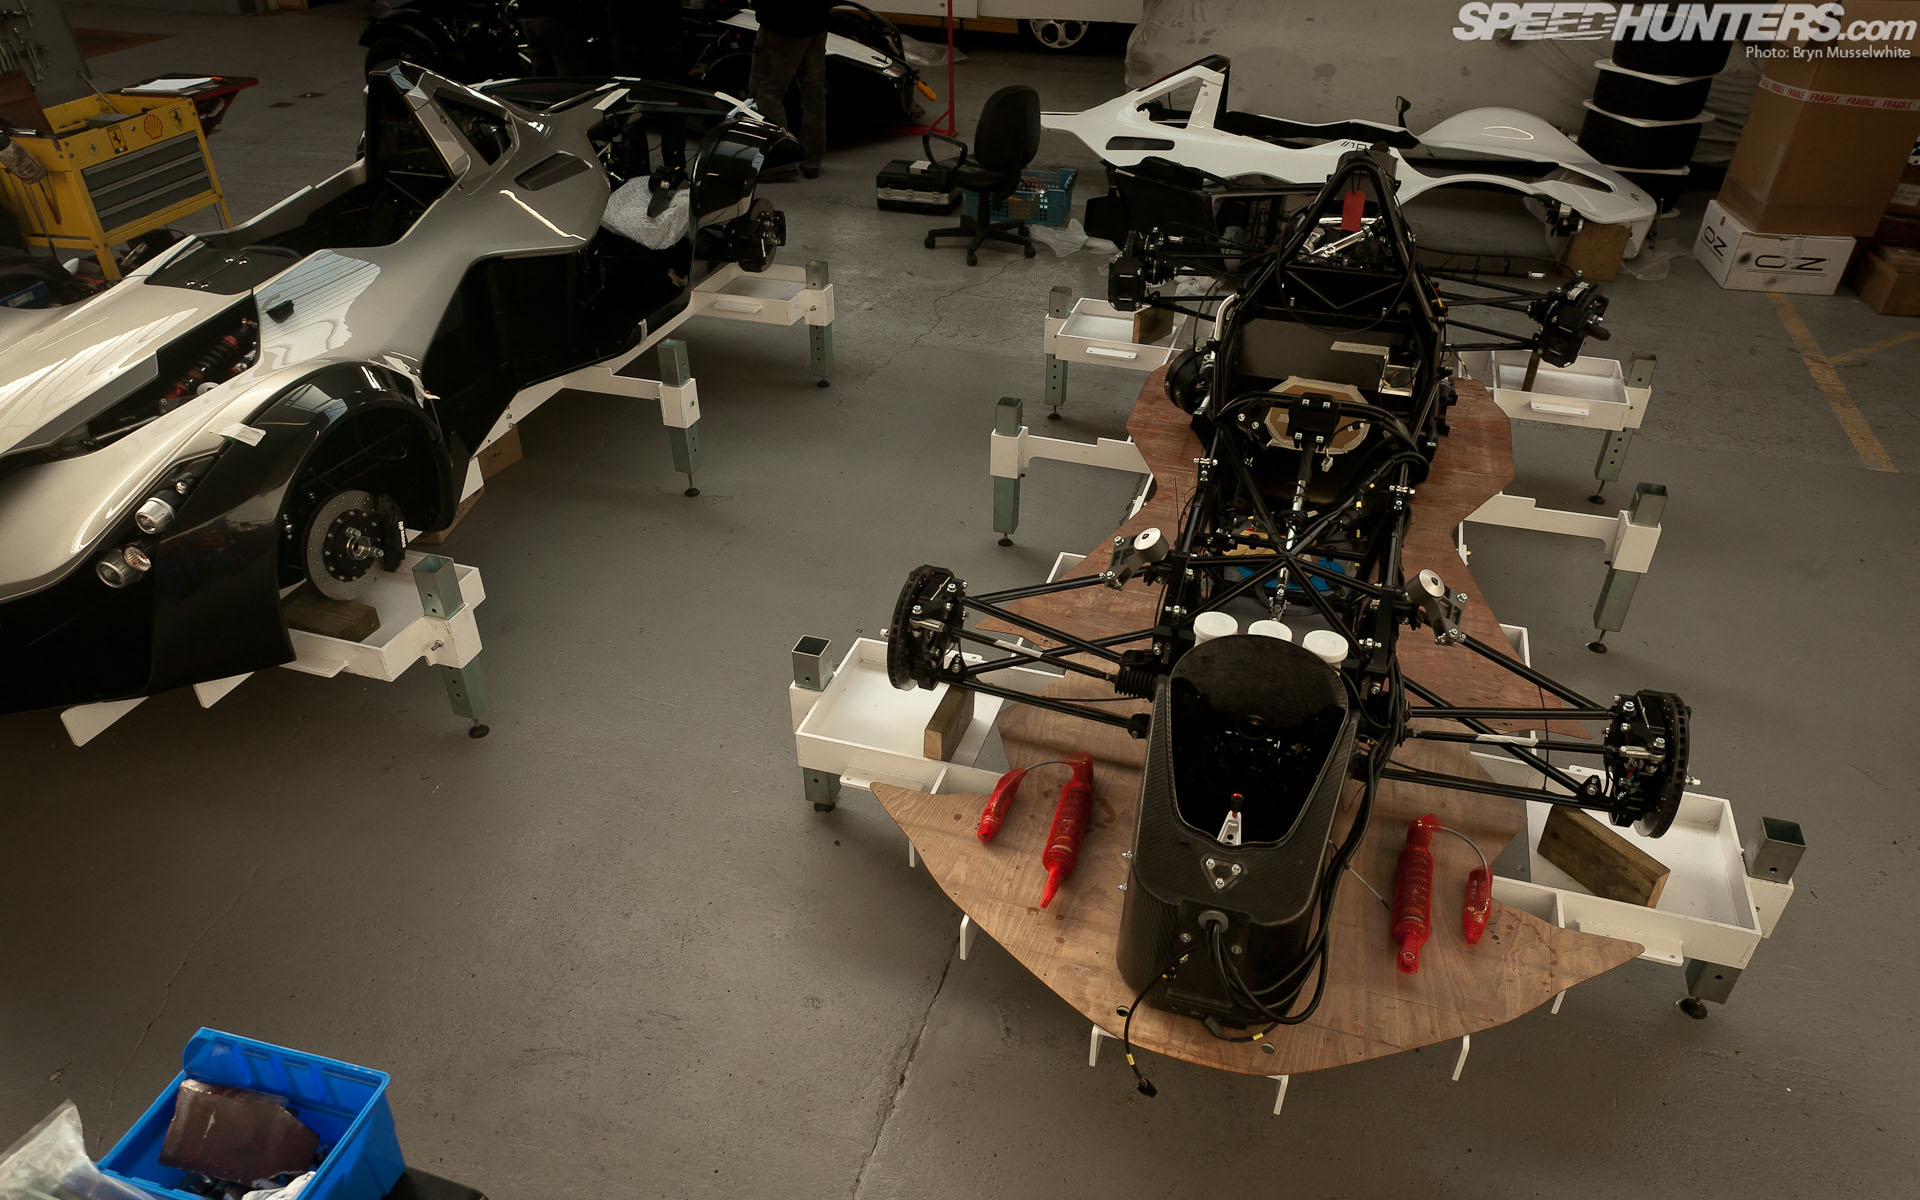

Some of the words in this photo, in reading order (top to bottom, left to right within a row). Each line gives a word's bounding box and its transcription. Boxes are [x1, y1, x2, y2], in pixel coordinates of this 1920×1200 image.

[1809, 92, 1841, 104] FRAGILE
[1846, 96, 1878, 107] FRAGILE
[1882, 100, 1913, 110] FRAGILE
[1704, 226, 1728, 257] OZ
[1755, 254, 1827, 271] OZ
